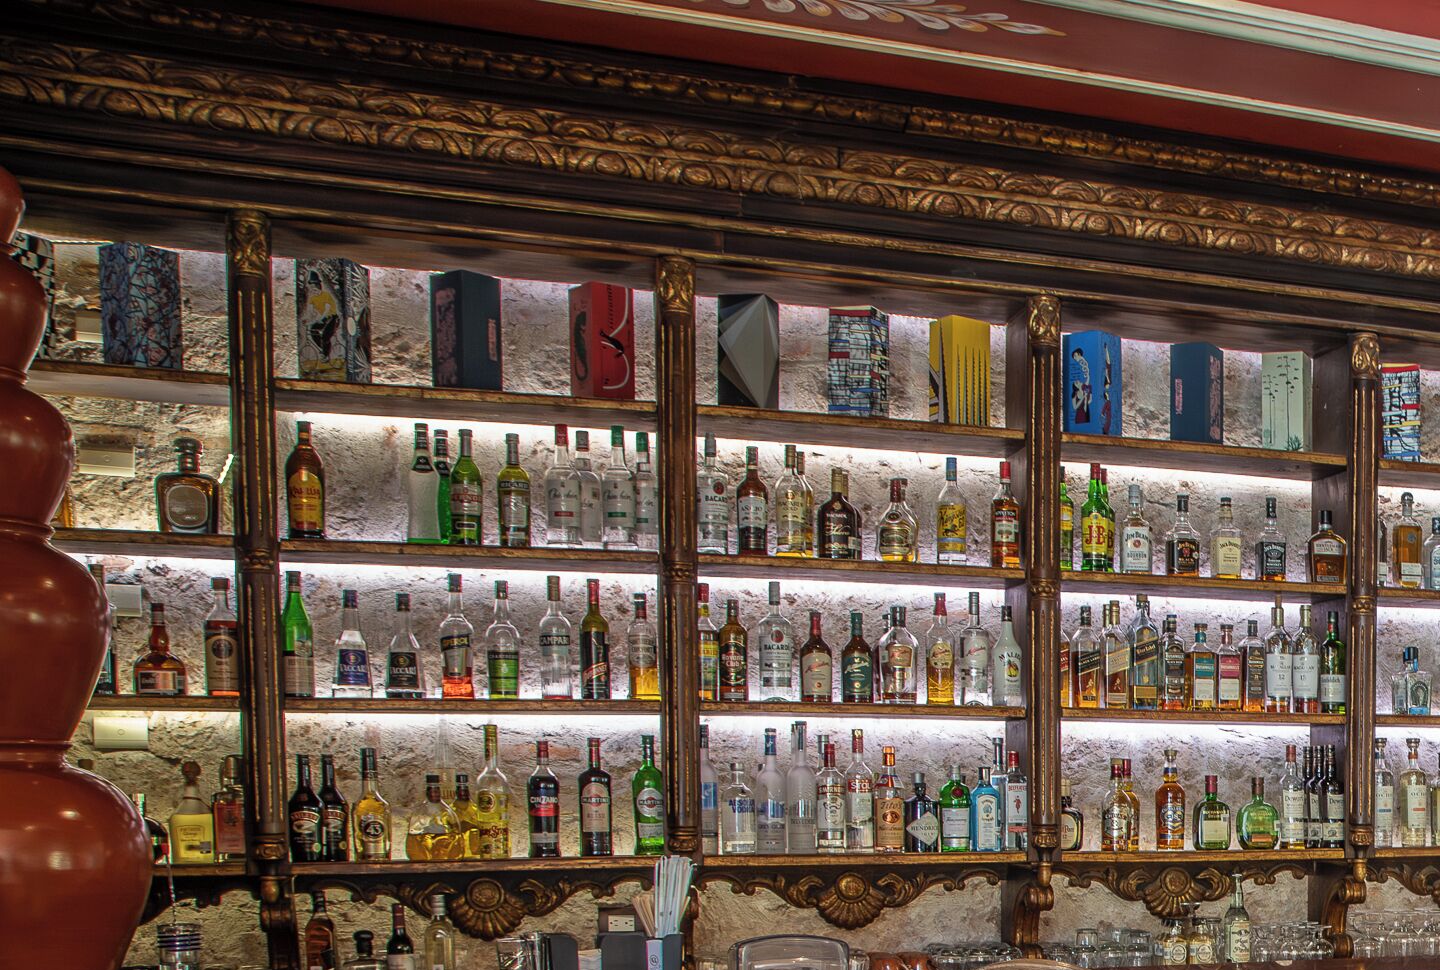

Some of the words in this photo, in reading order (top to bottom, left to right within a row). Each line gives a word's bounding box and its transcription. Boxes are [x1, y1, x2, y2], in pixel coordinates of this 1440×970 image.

[500, 481, 529, 489] RICARD
[529, 795, 559, 804] CINZANO
[366, 823, 381, 835] 43
